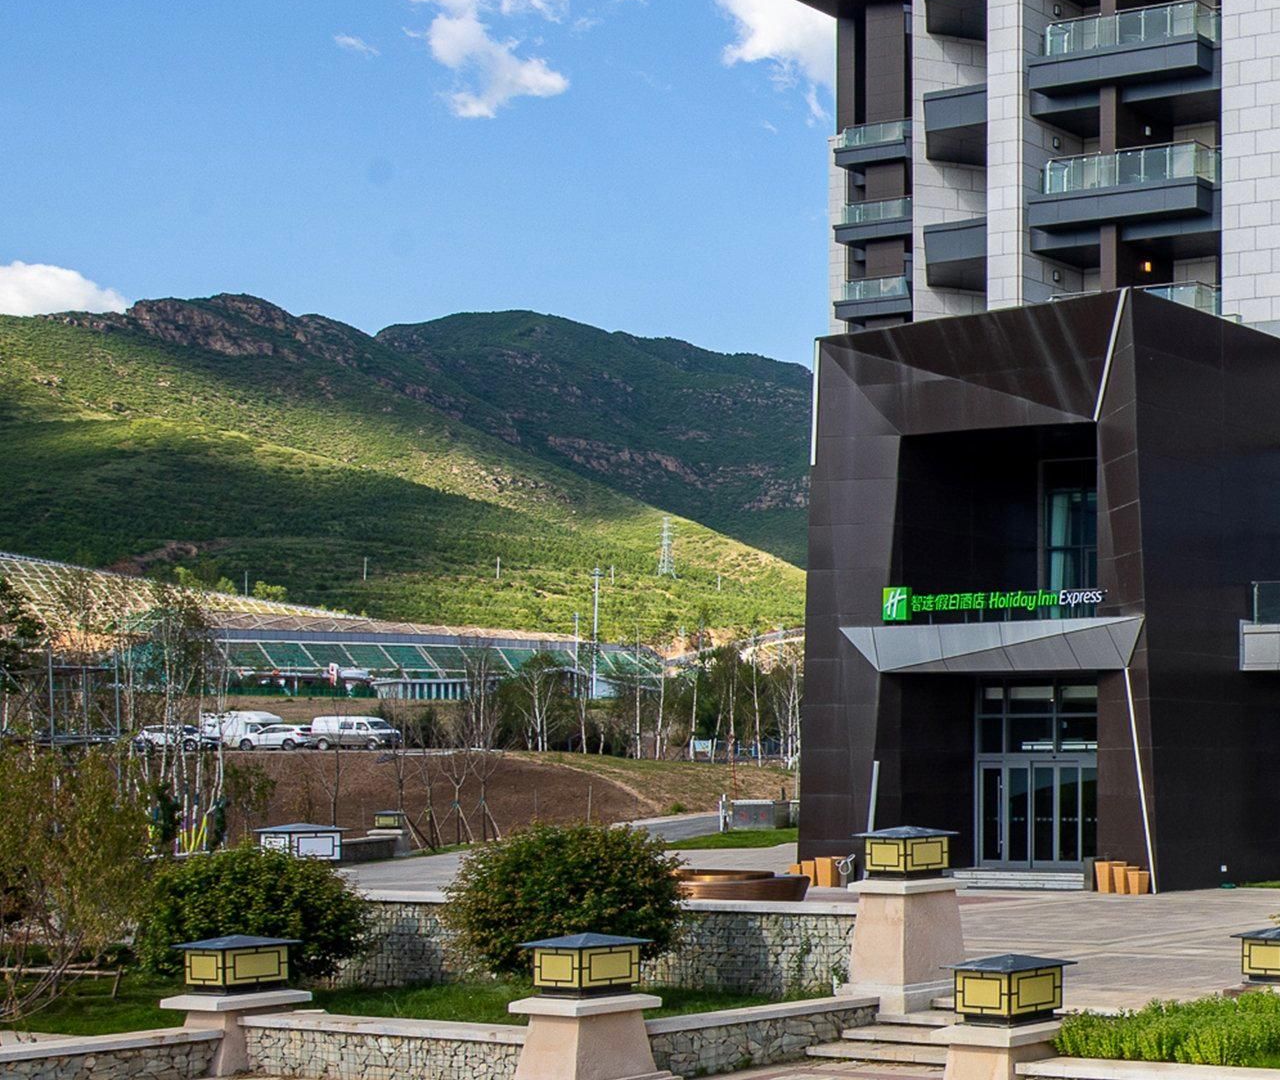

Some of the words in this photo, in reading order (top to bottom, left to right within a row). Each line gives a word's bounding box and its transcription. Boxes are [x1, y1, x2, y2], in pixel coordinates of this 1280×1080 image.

[911, 593, 986, 612] 智选假日酒店
[989, 591, 1036, 611] Holiday
[1037, 589, 1058, 606] Inn
[1059, 589, 1103, 608] Express
